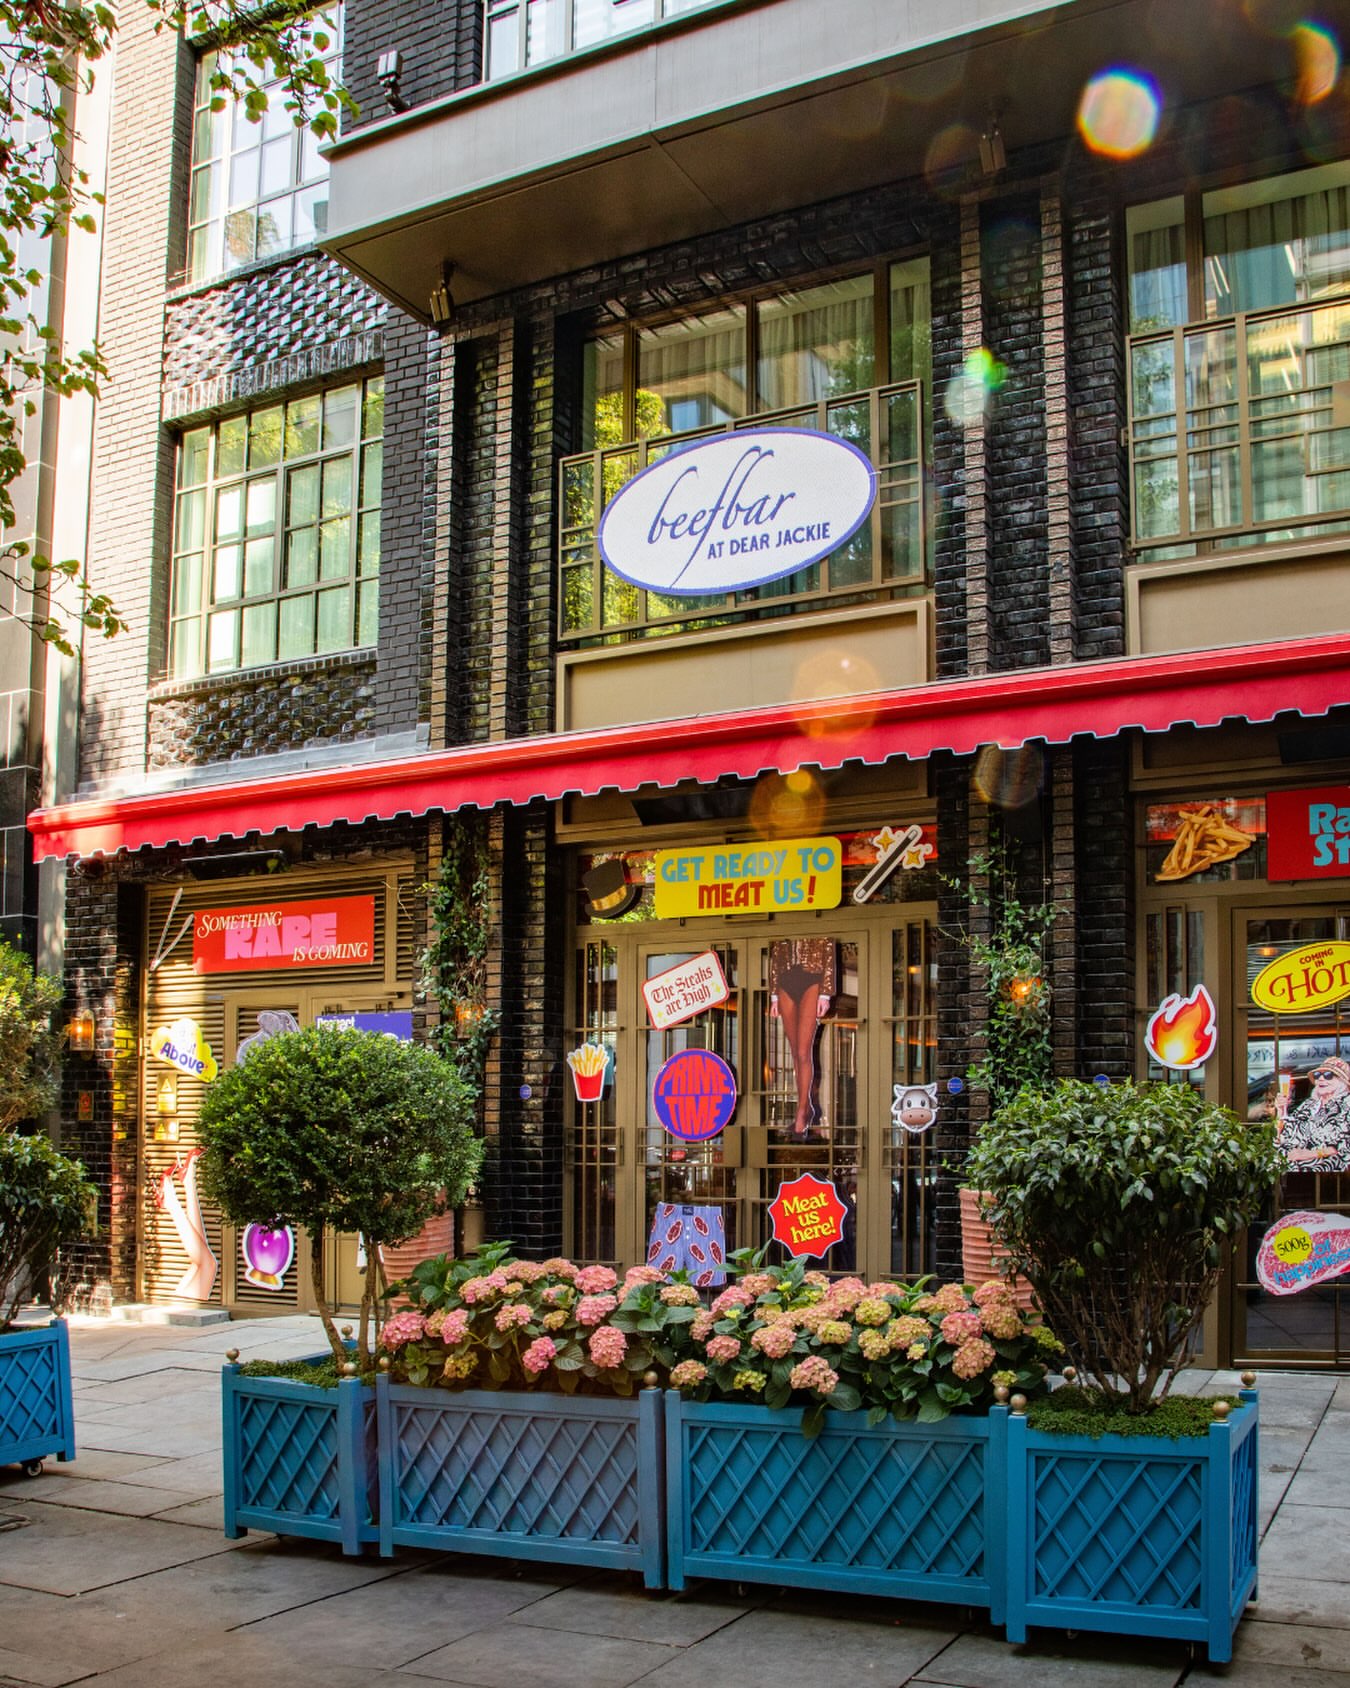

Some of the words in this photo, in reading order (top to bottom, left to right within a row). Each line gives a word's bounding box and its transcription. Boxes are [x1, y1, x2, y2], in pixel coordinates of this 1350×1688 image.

[648, 445, 796, 588] beefbar
[707, 542, 724, 559] AT
[729, 534, 769, 557] DEAR
[776, 522, 831, 548] JACKIE
[1309, 803, 1350, 835] Ra
[661, 856, 705, 883] GET
[714, 850, 788, 879] READY
[797, 847, 835, 873] TO
[698, 881, 765, 909] MEAT
[773, 876, 816, 905] US!
[225, 912, 337, 959] RARE
[293, 946, 306, 961] IS
[308, 942, 368, 961] COMING
[1299, 948, 1334, 964] COMING
[1314, 959, 1325, 968] IN
[651, 985, 675, 1004] The
[674, 966, 713, 993] Steaks
[1269, 960, 1350, 1004] HOT
[665, 999, 683, 1016] are
[682, 983, 711, 1008] High
[159, 1041, 205, 1075] Above
[658, 1054, 730, 1096] PRIME
[665, 1096, 722, 1135] TIME
[782, 1191, 828, 1217] Meat
[798, 1211, 820, 1227] us
[790, 1216, 836, 1244] here!
[1277, 1236, 1309, 1256] 500g
[1273, 1247, 1350, 1285] happines
